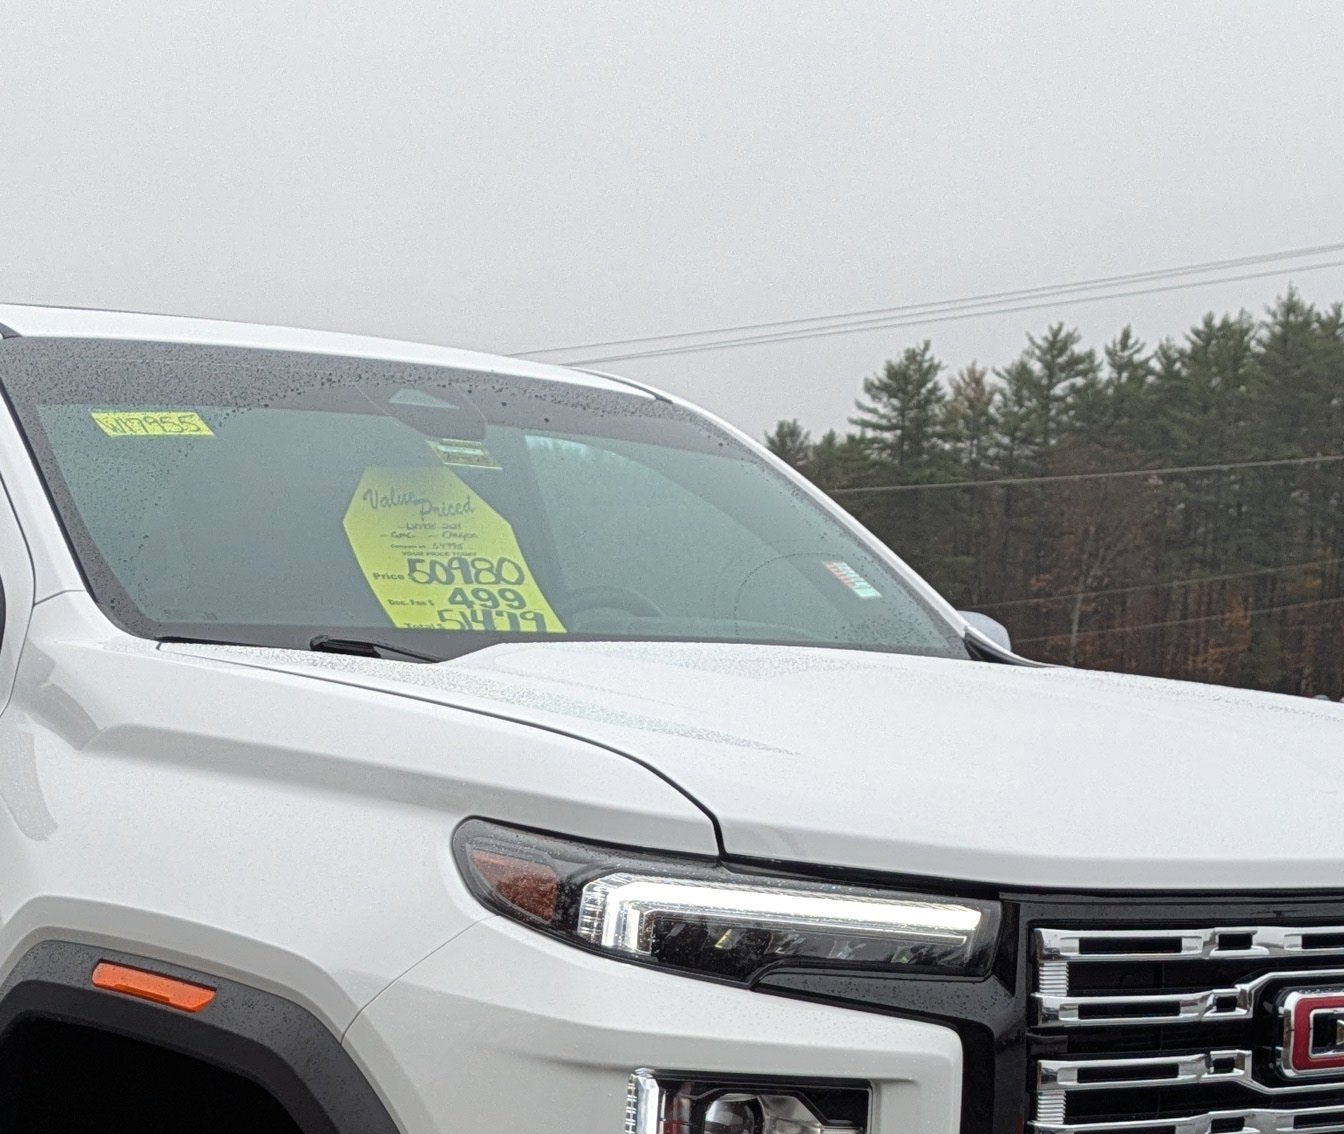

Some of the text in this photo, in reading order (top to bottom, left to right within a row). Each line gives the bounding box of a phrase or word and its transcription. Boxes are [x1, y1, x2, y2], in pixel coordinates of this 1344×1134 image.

[362, 487, 416, 510] Value
[417, 495, 475, 521] Priced
[372, 556, 525, 586] Price 50980
[448, 587, 528, 610] 499
